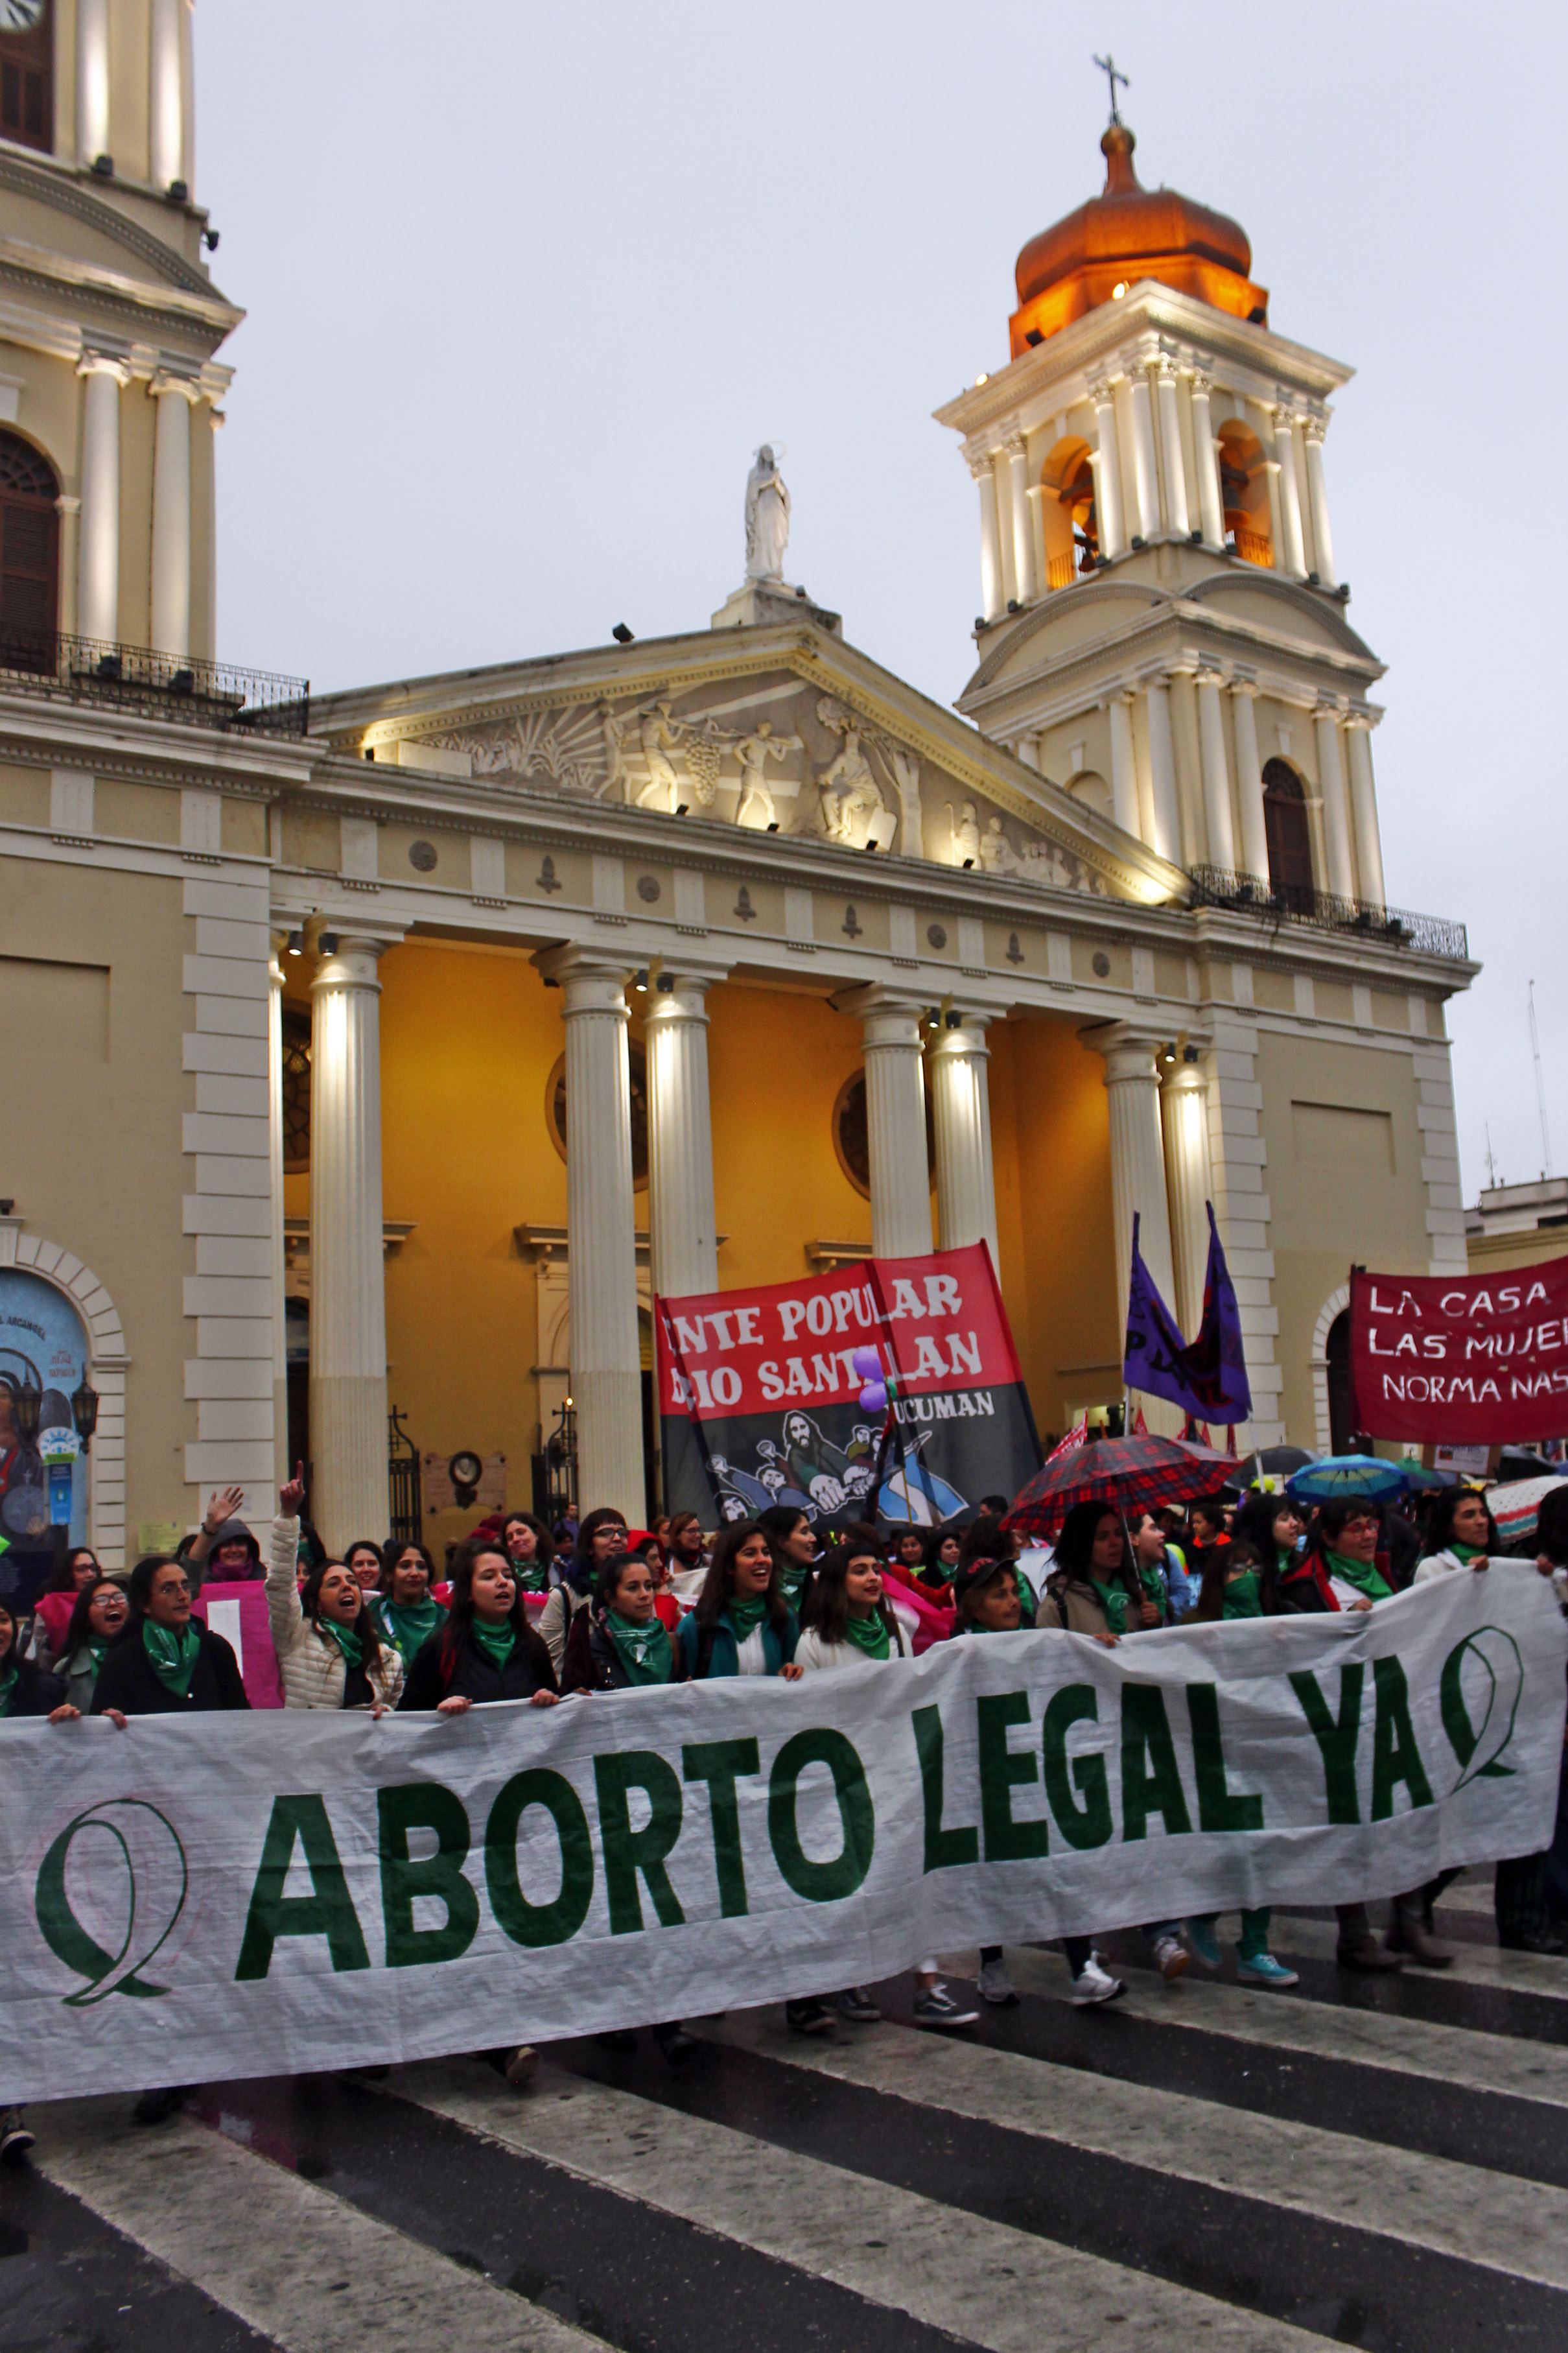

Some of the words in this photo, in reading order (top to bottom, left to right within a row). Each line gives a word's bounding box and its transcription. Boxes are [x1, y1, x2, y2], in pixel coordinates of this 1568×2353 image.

[1370, 1286, 1422, 1317] LA
[1440, 1282, 1551, 1318] CASA
[1369, 1329, 1447, 1359] LAS
[1383, 1374, 1503, 1402] NORMA
[884, 1391, 995, 1424] UCUMAN
[235, 1727, 875, 1980] ABORTO
[912, 1682, 1264, 1874] LEGAL
[1288, 1654, 1434, 1825] YA
